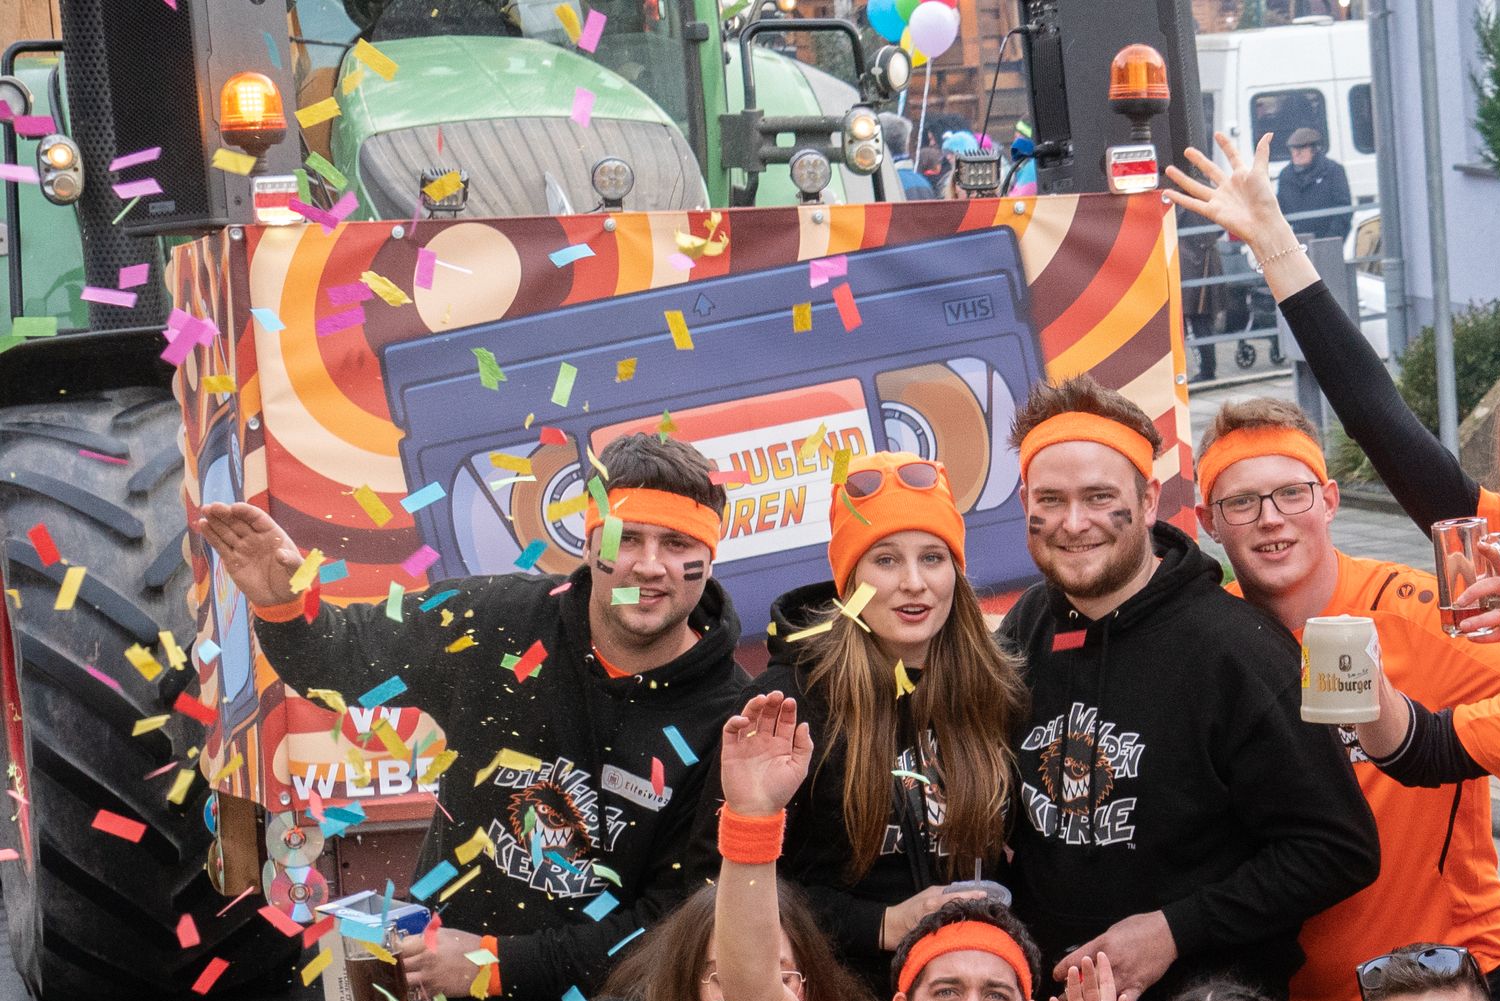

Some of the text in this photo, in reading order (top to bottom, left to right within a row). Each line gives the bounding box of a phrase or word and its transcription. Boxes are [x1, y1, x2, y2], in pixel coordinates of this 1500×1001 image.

[947, 298, 990, 321] VHS
[1317, 672, 1372, 694] Bitburger
[1021, 781, 1138, 846] KERLE
